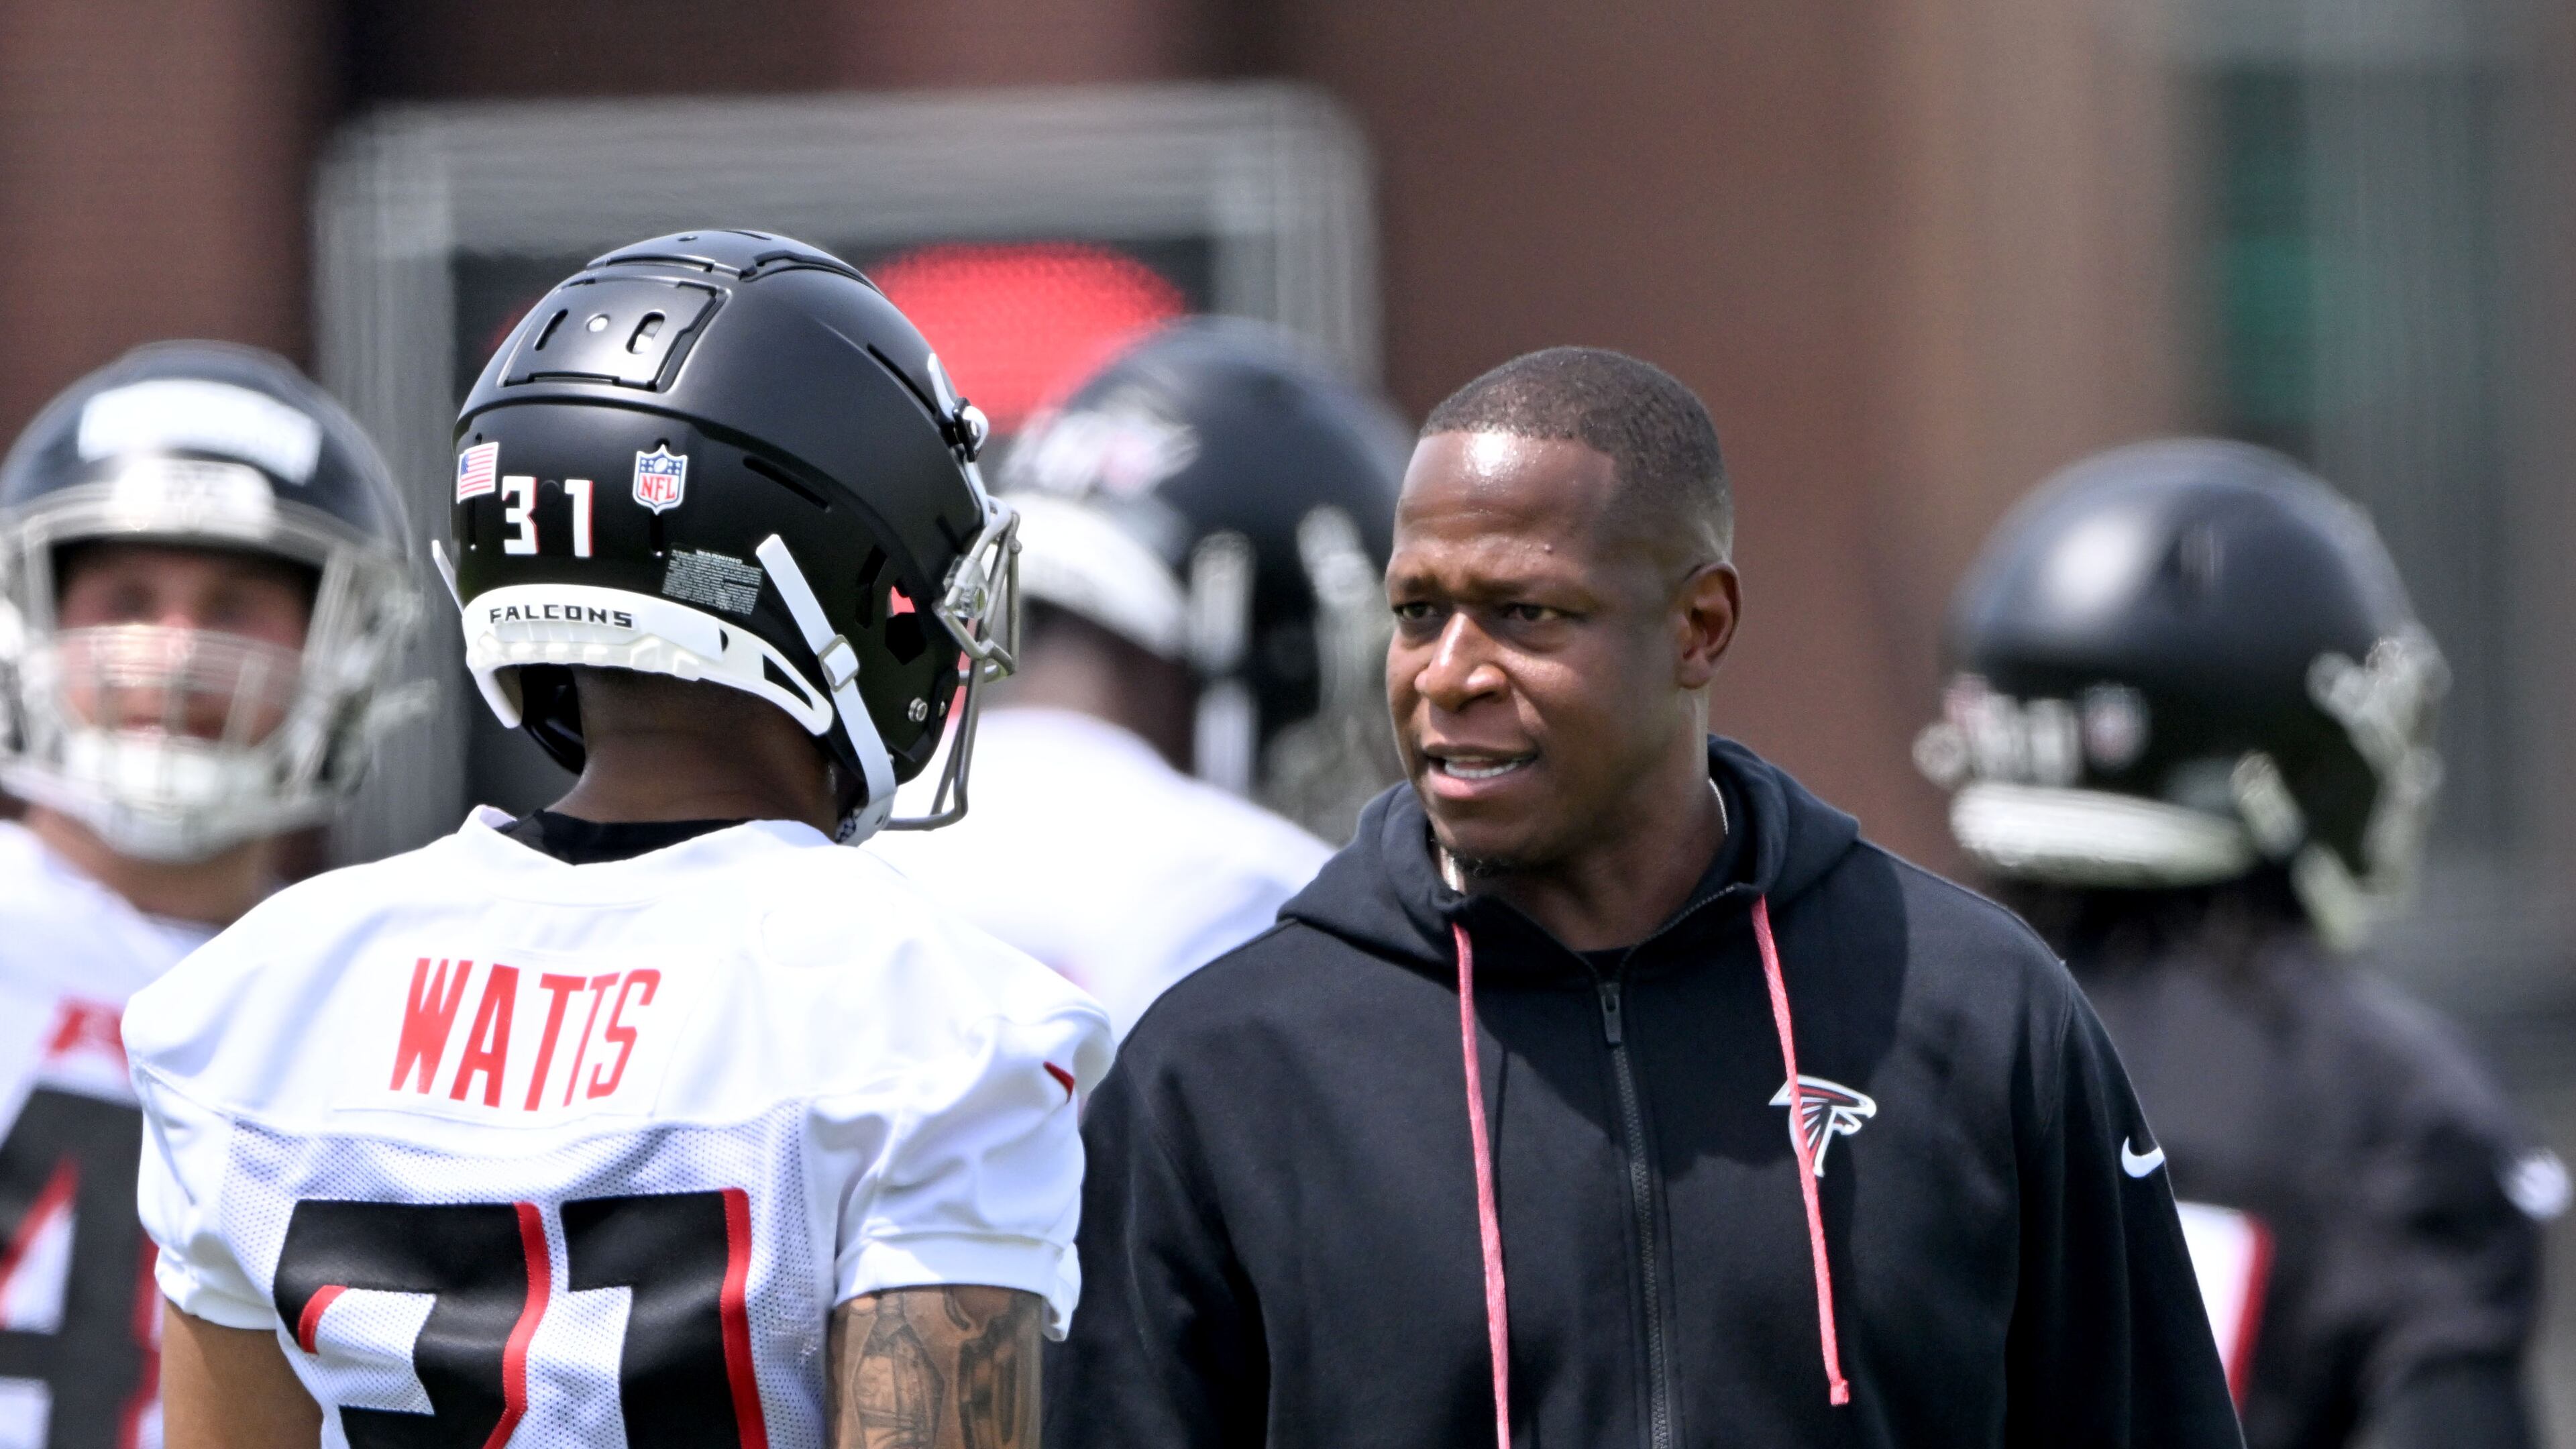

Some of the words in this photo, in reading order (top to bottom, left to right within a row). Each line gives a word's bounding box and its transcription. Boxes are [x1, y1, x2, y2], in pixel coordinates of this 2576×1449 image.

[641, 474, 676, 501] NFL
[502, 476, 594, 558] 31
[489, 604, 633, 629] FALCONS
[390, 957, 661, 1111] WATTS
